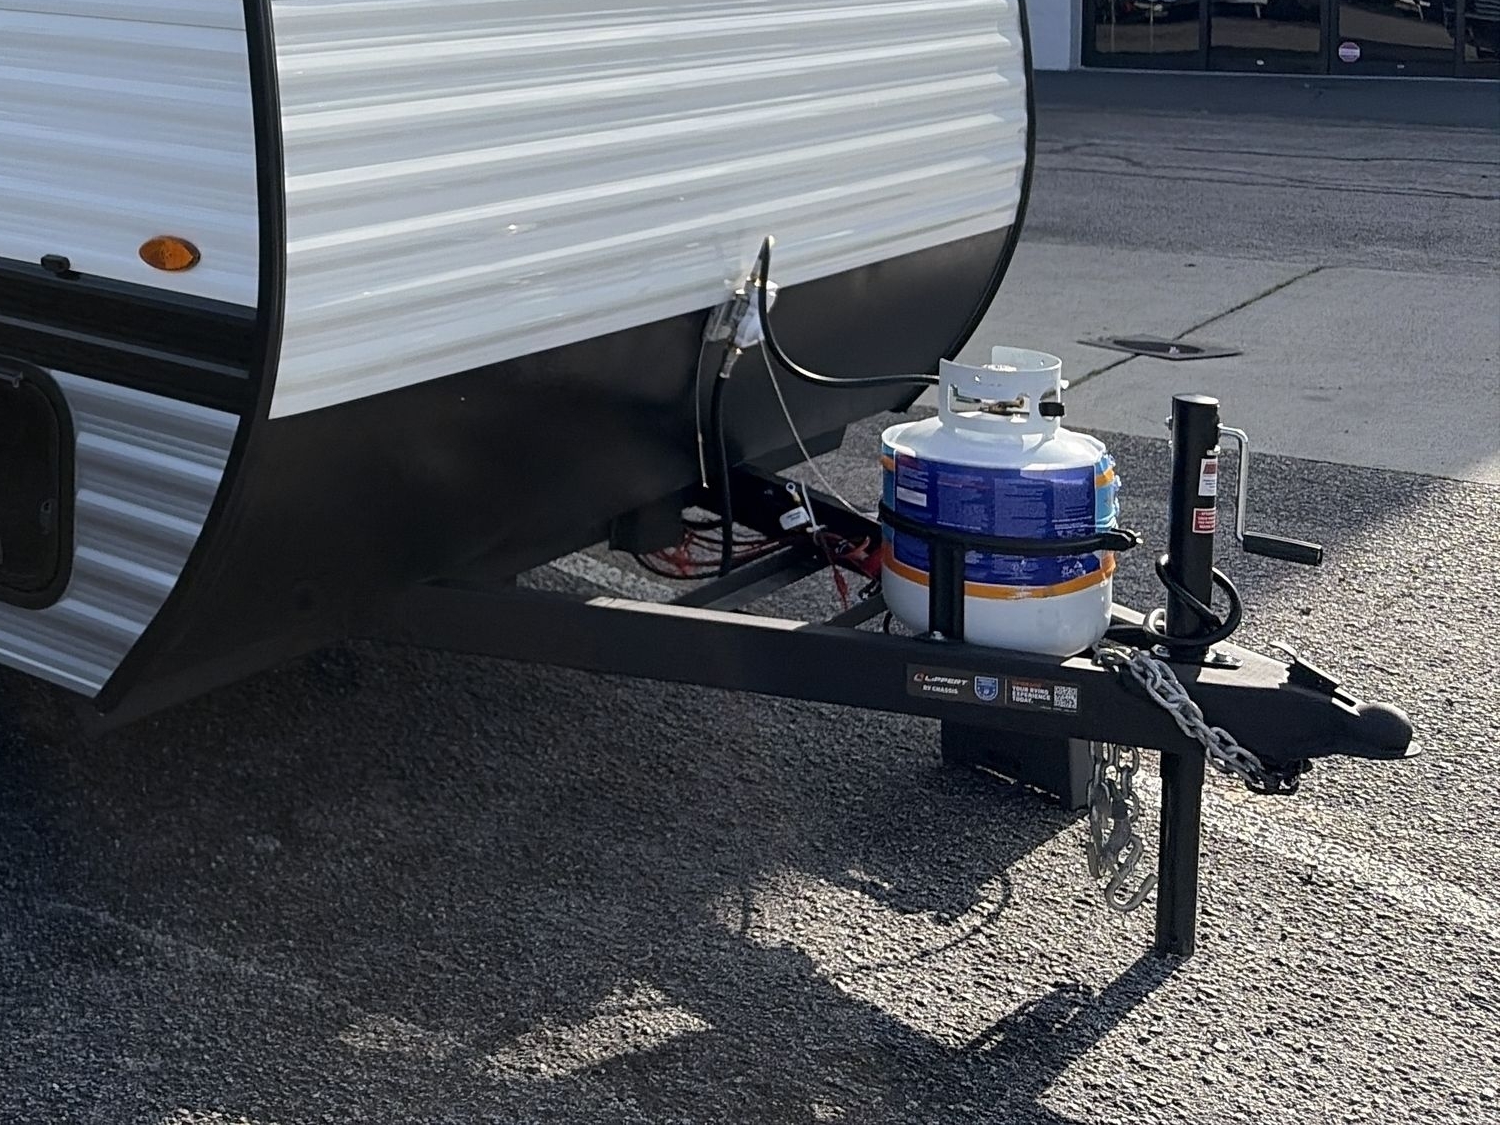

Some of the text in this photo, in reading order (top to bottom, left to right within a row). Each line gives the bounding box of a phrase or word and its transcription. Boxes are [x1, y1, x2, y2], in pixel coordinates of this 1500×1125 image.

[932, 685, 959, 695] CHASSIS
[1011, 685, 1029, 693] YOUR
[1011, 690, 1051, 701] EXPERIENCE
